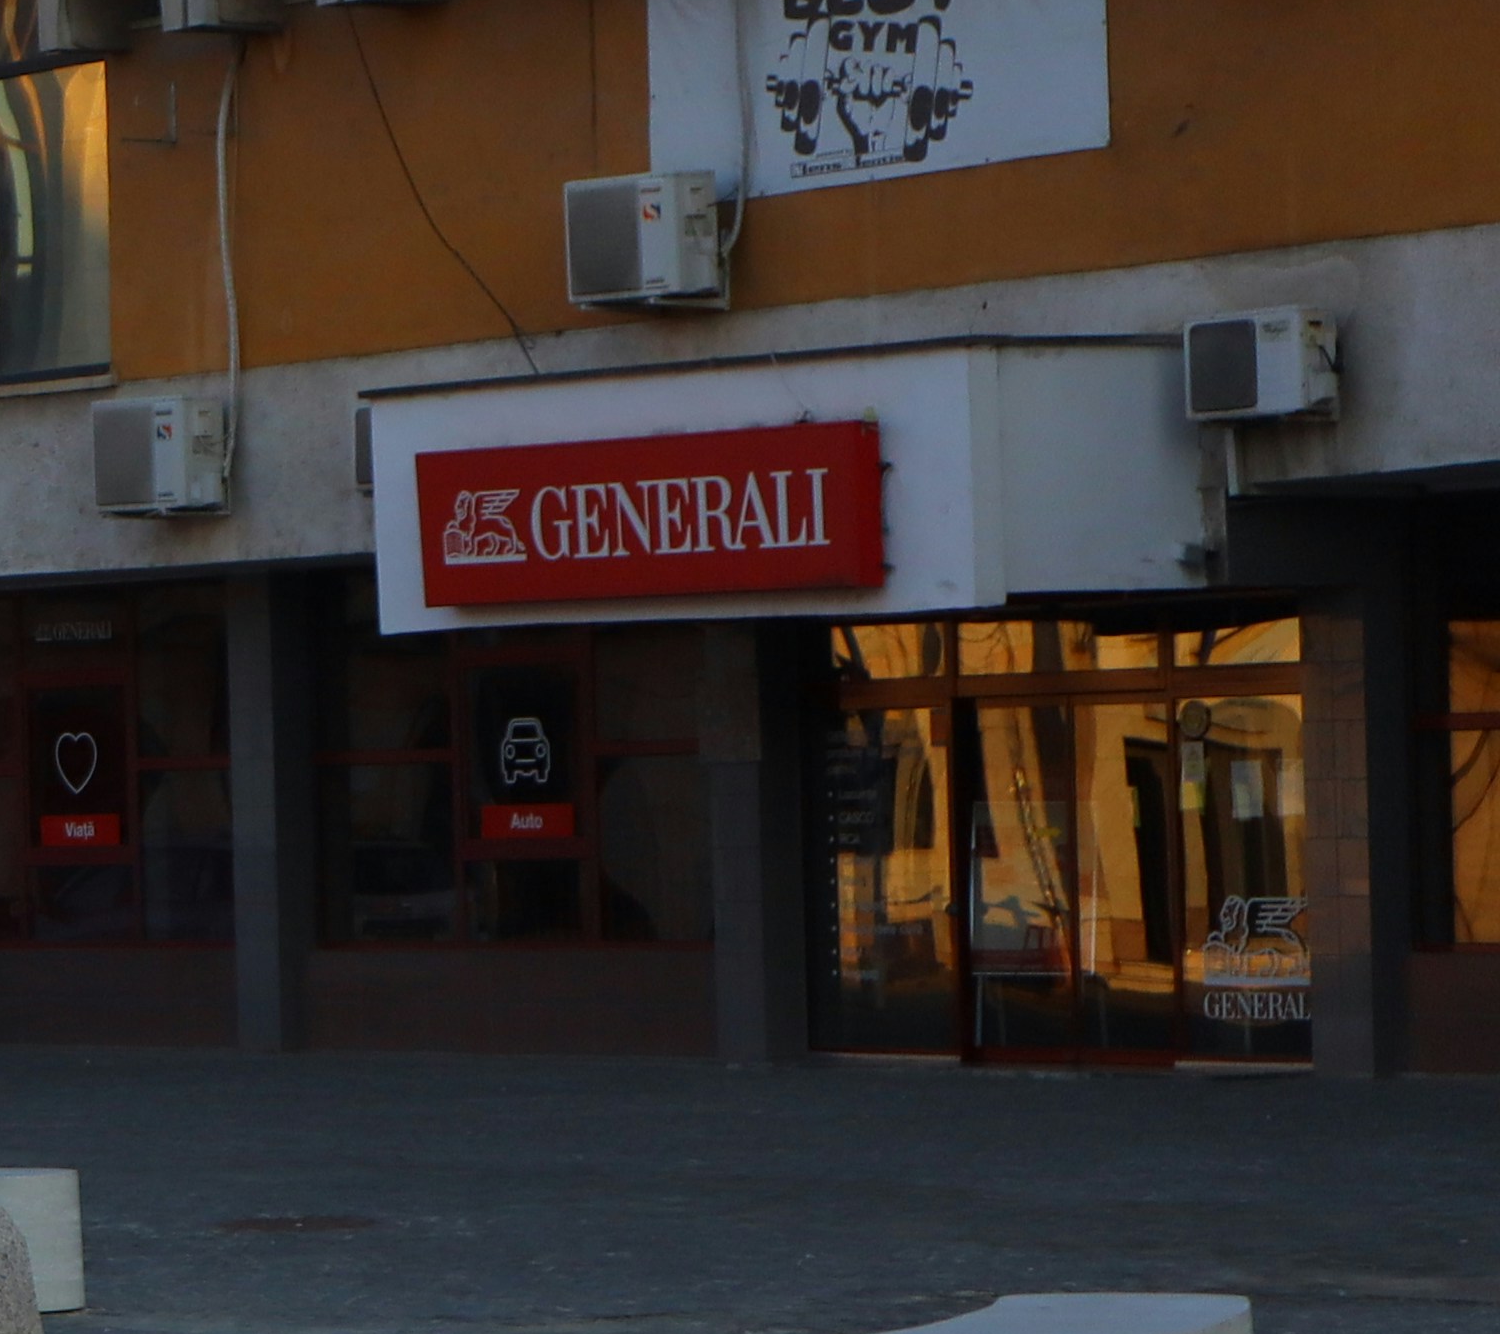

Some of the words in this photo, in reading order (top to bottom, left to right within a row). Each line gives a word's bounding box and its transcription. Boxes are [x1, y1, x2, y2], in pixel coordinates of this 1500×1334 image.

[828, 19, 920, 55] GYM
[530, 467, 830, 561] GENERALI
[511, 812, 544, 829] Auto
